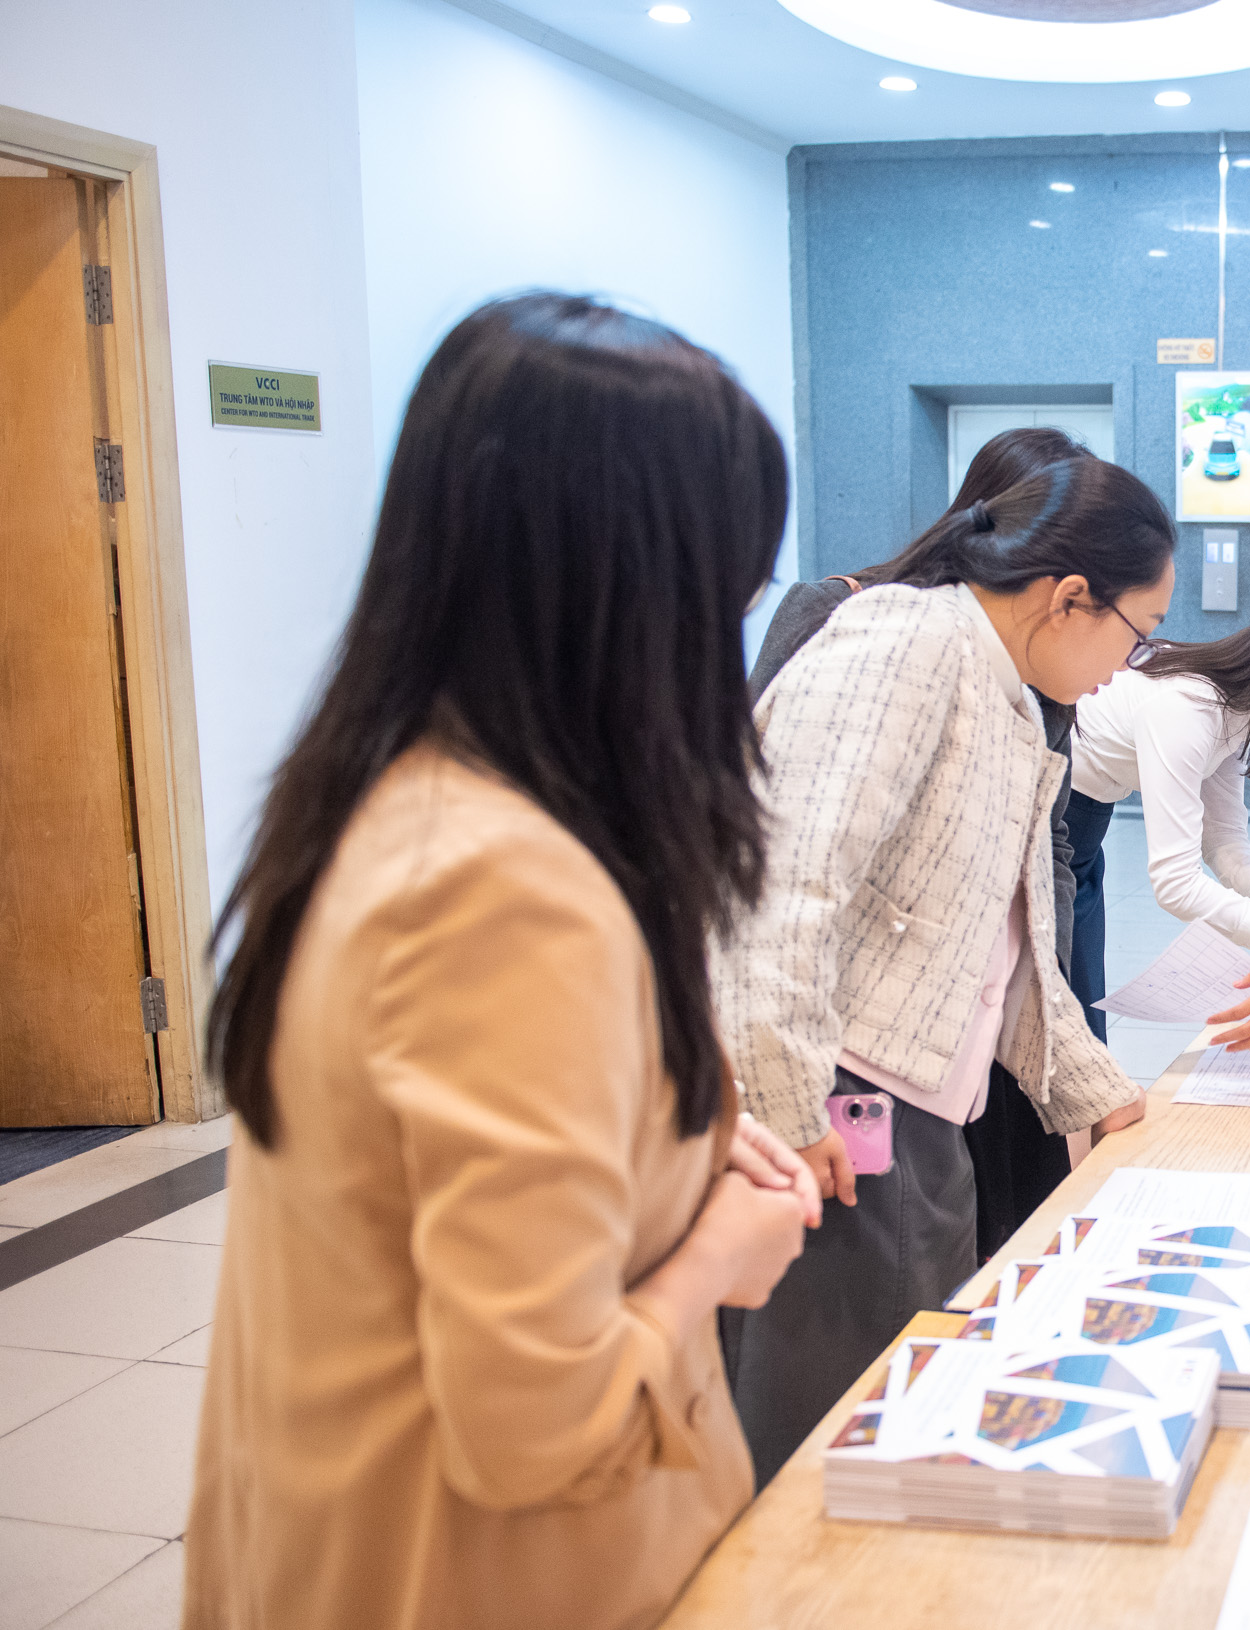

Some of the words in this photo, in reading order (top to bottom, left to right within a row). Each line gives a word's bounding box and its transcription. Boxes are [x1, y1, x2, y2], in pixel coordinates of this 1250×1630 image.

[256, 377, 280, 390] VCCI
[219, 393, 242, 404] TRUNG
[244, 394, 258, 405] TÂM
[259, 397, 274, 407] WTO
[275, 396, 284, 408] VÀ
[284, 397, 296, 411] HỘI
[297, 399, 314, 411] NHẬP
[221, 408, 238, 416] CENTER
